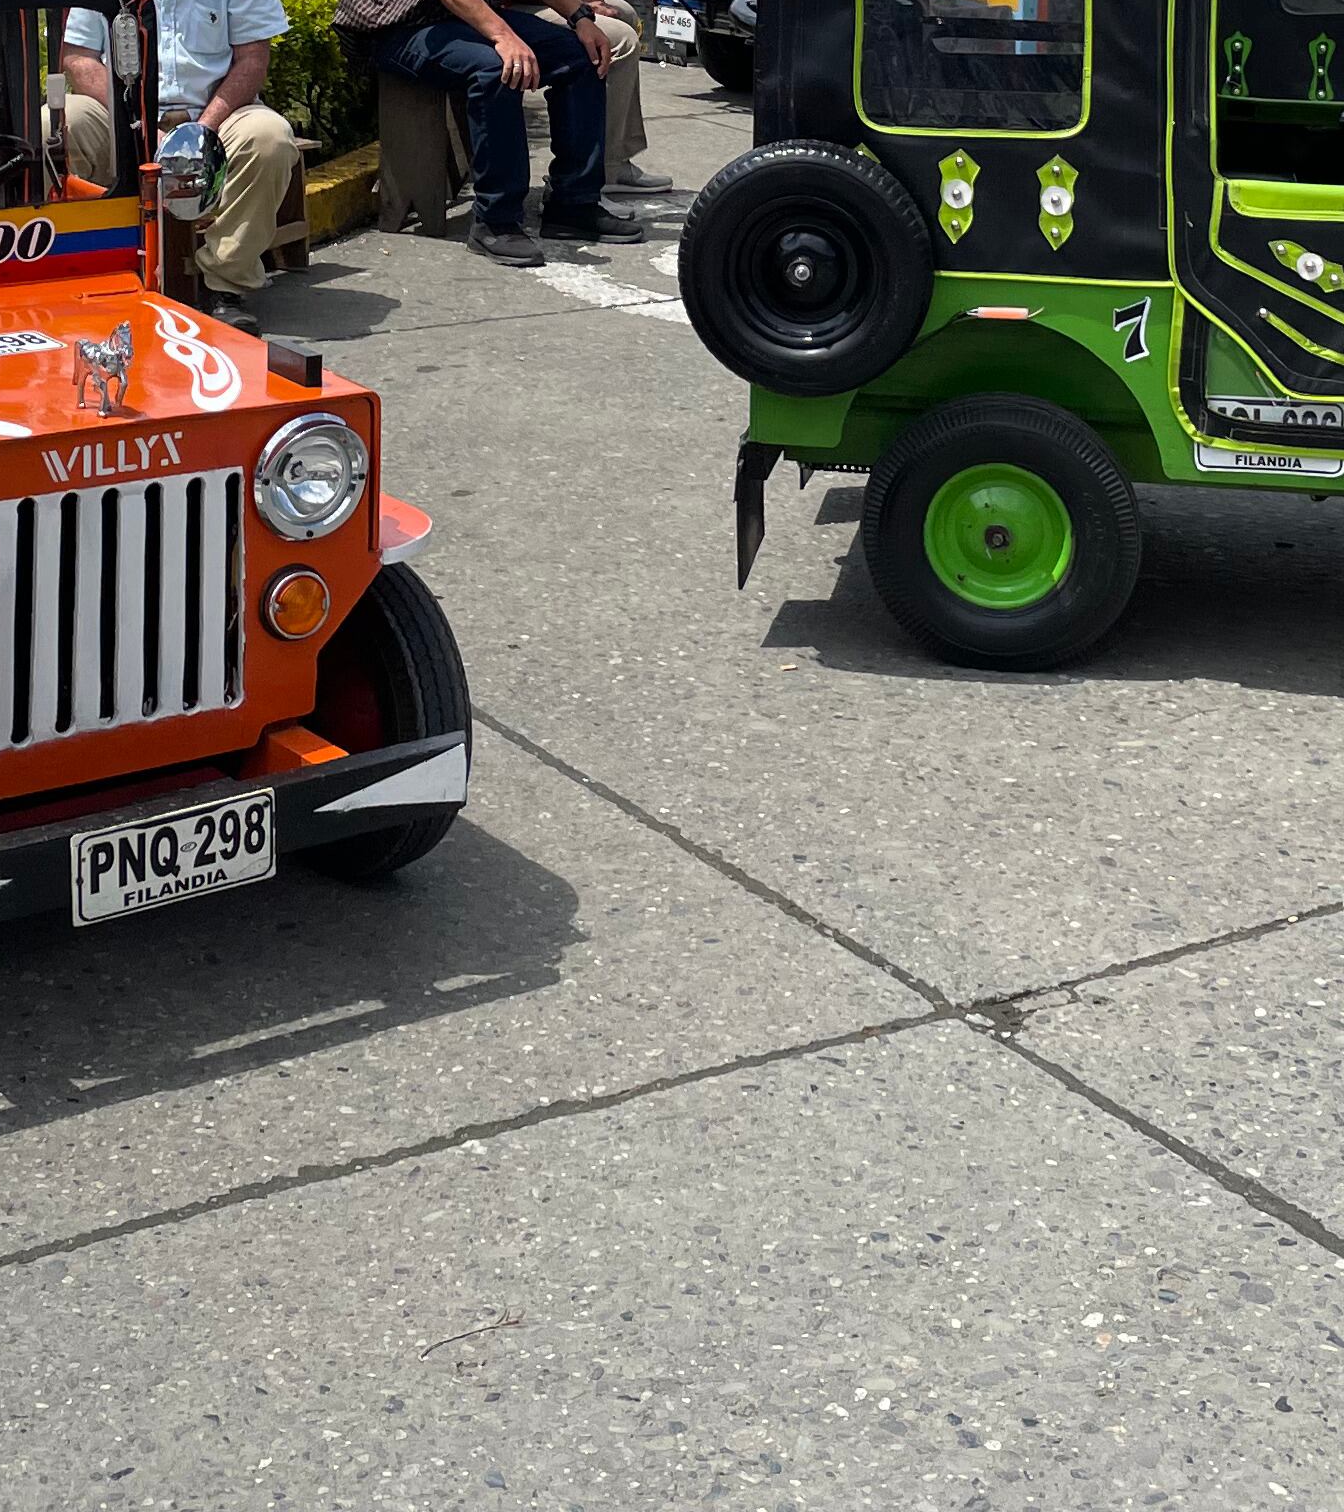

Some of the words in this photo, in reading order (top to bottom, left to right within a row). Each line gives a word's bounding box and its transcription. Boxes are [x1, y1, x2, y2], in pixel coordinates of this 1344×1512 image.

[1112, 296, 1151, 363] 7
[1235, 454, 1302, 469] FILANDIA
[89, 825, 181, 895] PNQ
[193, 803, 266, 869] 298
[123, 868, 228, 907] FILANDIA
